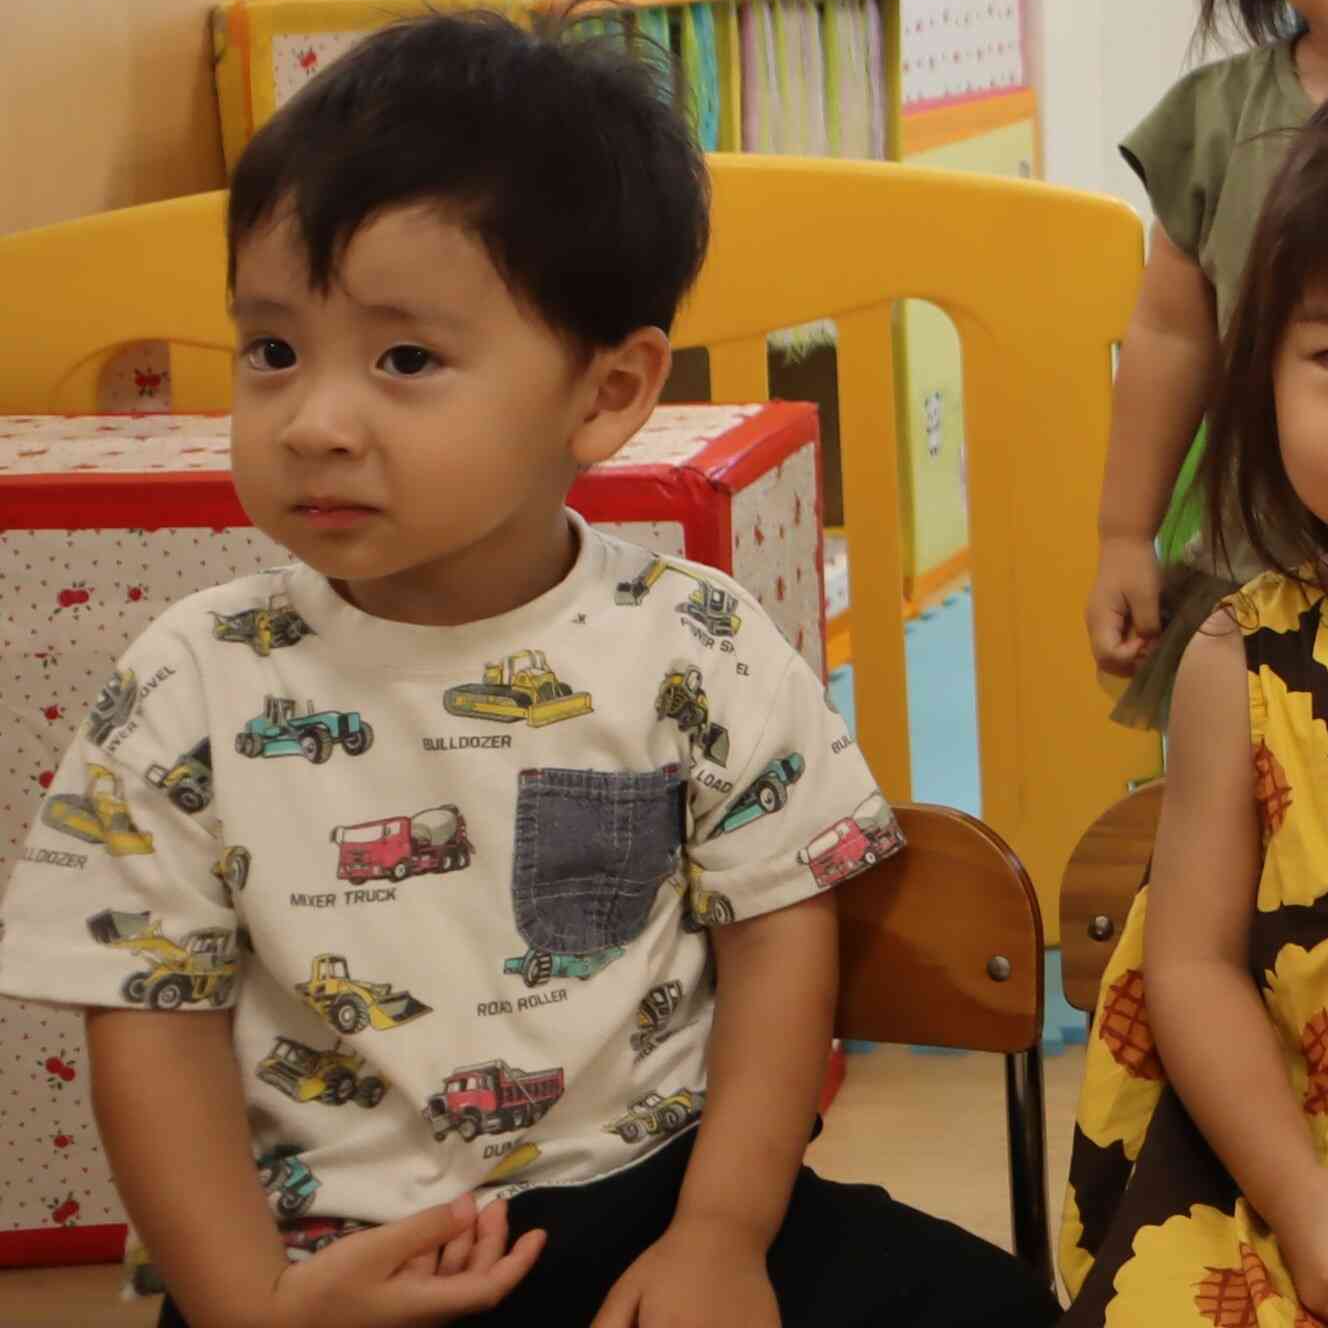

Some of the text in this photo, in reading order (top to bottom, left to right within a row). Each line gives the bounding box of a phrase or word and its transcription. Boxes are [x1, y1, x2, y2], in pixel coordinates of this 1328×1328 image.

[422, 734, 513, 752] BULLDOZER
[289, 887, 397, 908] MIXER TRUCK
[517, 988, 568, 1012] ROLLER
